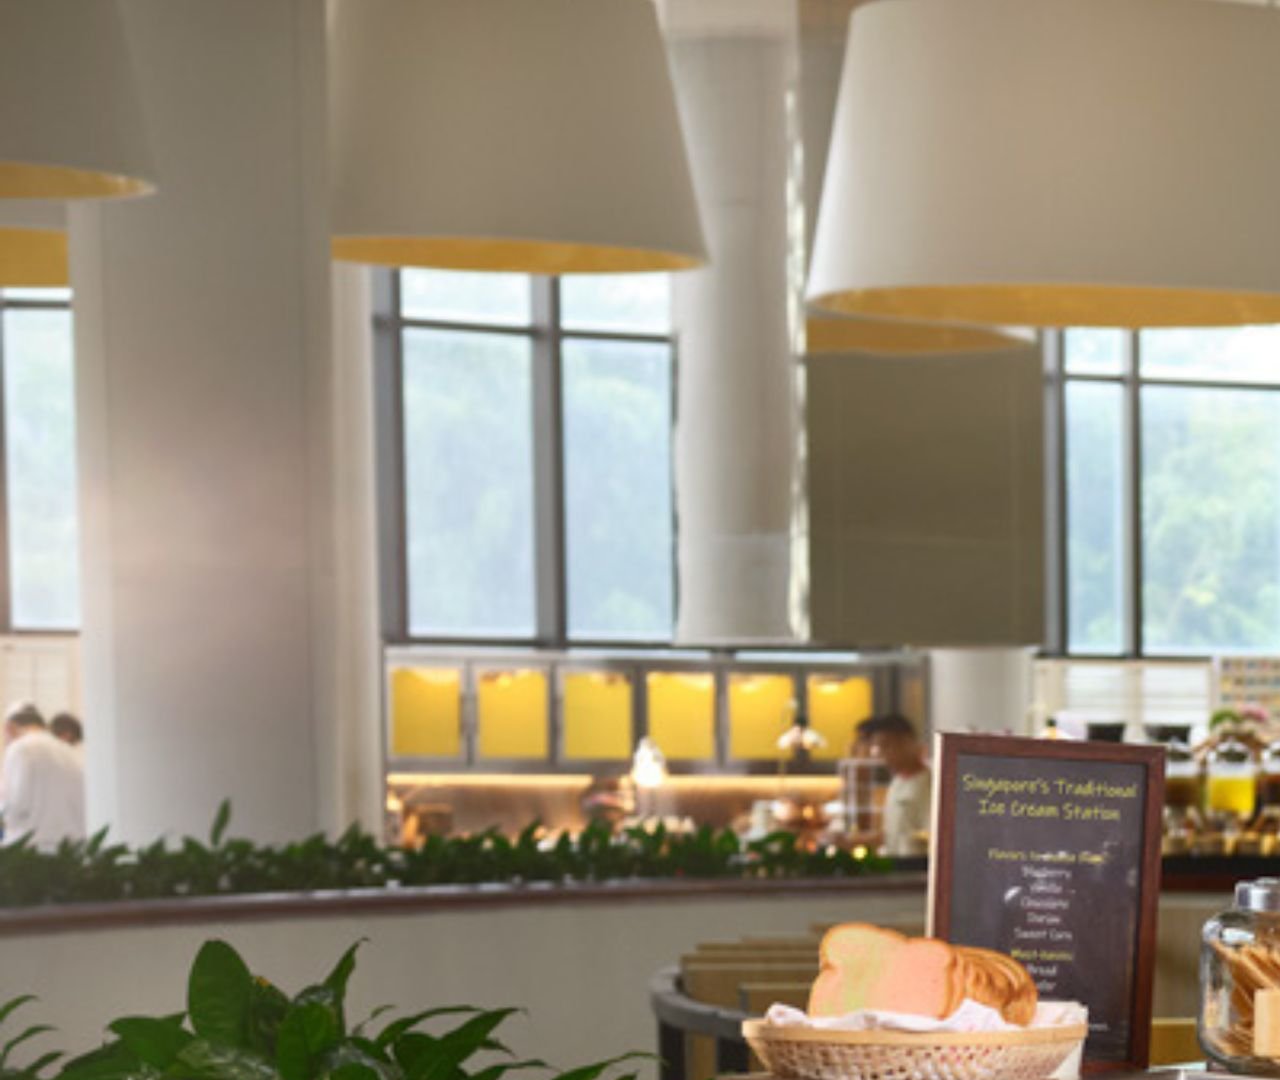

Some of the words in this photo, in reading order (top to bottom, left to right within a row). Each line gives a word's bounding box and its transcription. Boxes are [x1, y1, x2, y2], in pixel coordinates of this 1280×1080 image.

[962, 774, 1050, 798] Singapore's
[1054, 778, 1137, 798] Traditional
[979, 799, 1005, 815] Ice
[1010, 800, 1059, 818] Cream
[1063, 802, 1121, 821] Station
